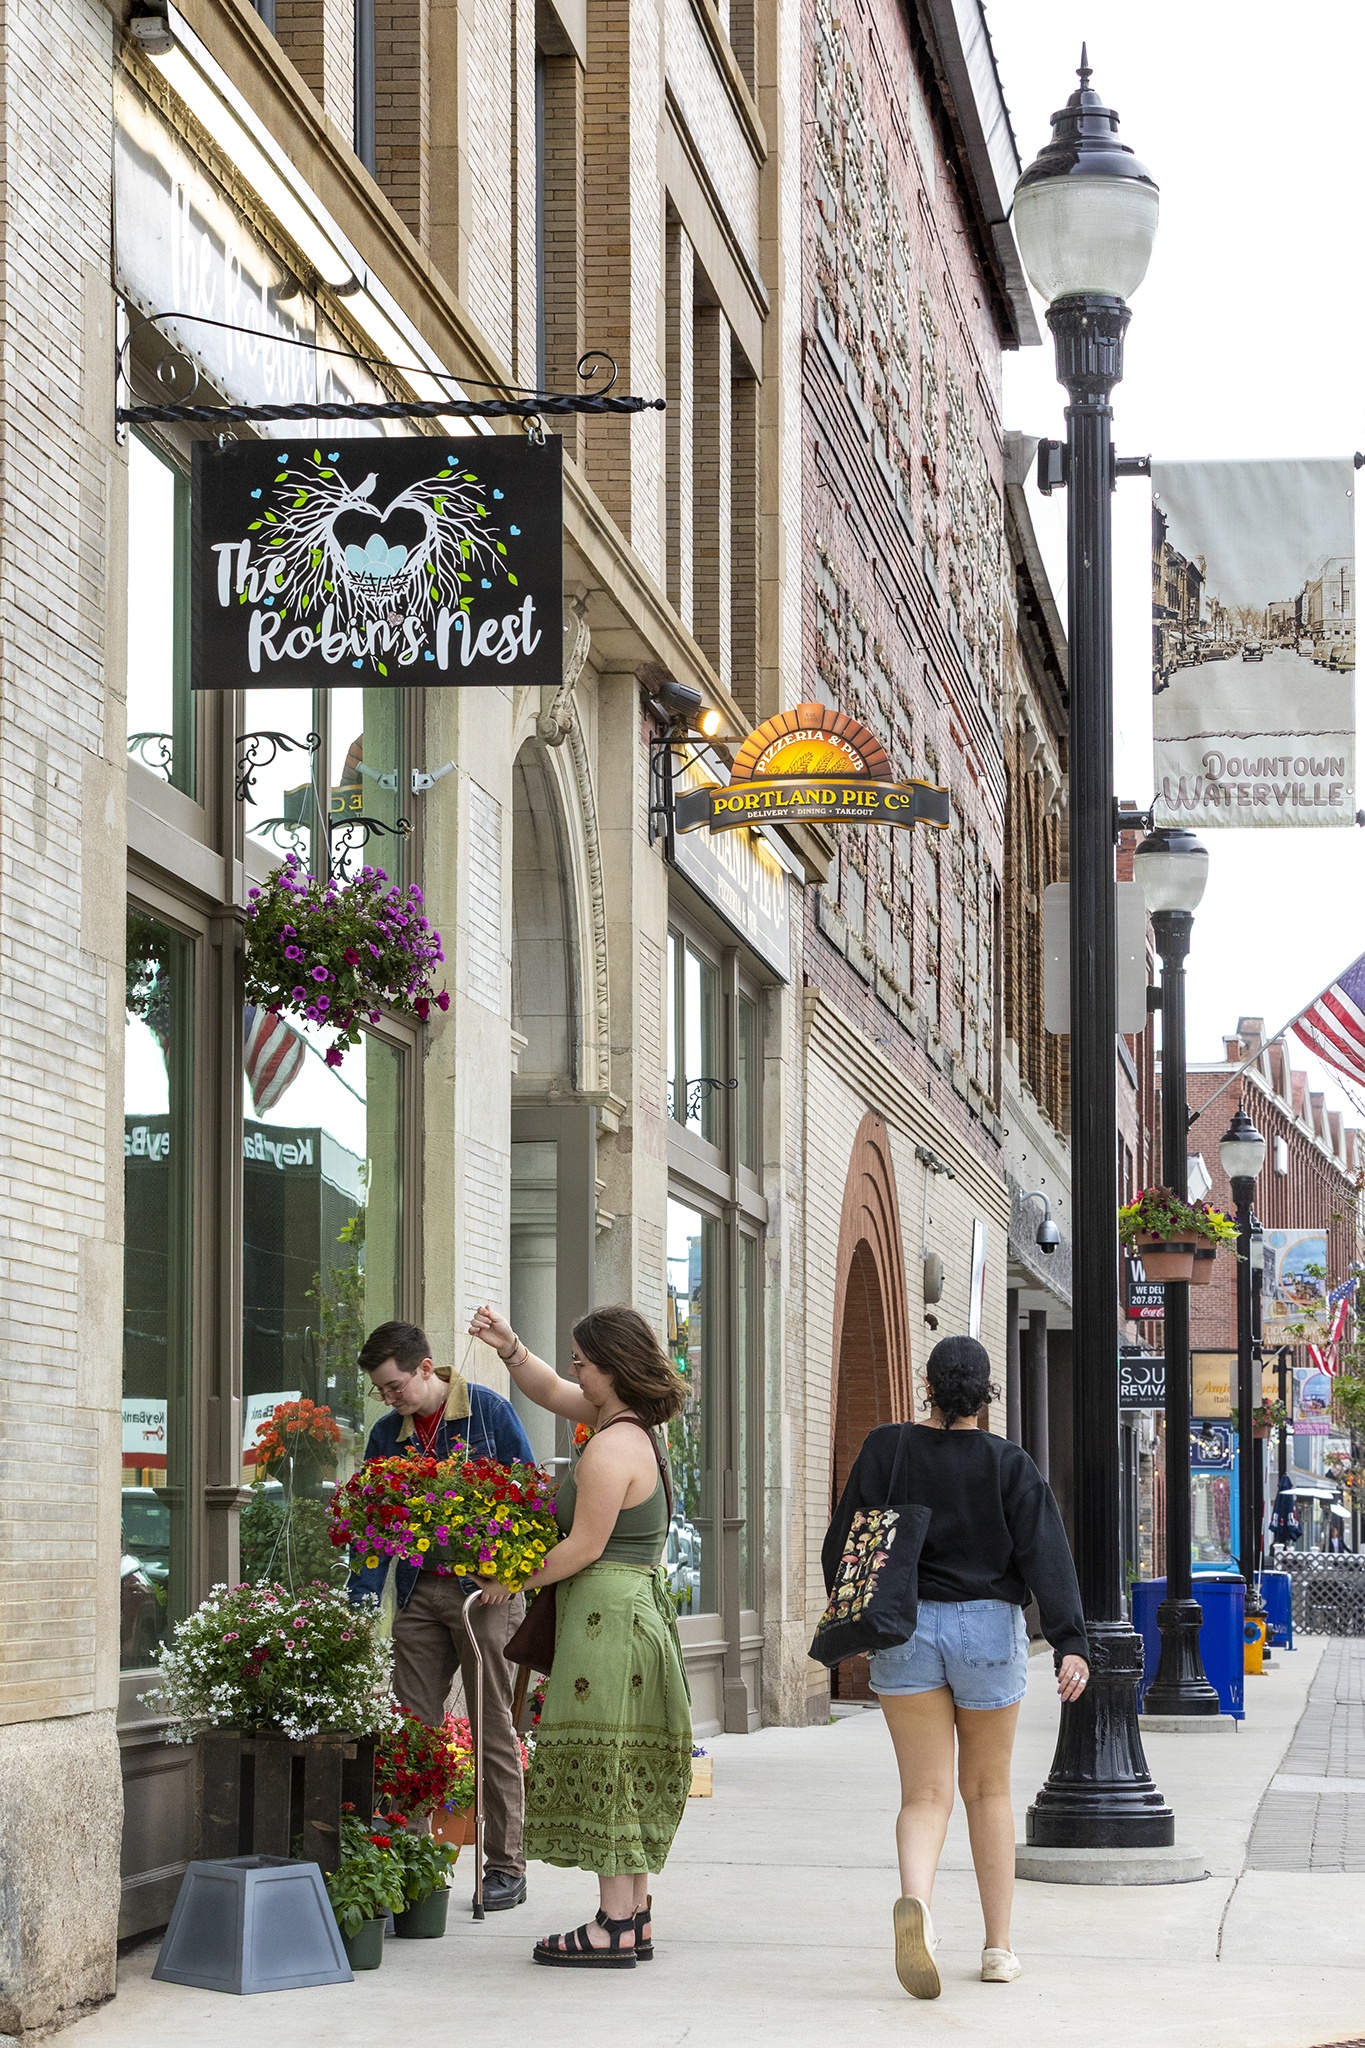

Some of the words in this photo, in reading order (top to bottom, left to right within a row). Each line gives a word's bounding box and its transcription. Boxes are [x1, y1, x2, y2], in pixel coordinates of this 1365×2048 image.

[211, 539, 296, 608] The
[436, 594, 543, 671] Nest
[757, 730, 824, 773] PIZZERIA
[829, 734, 841, 747] &
[841, 744, 864, 772] PUB
[713, 789, 837, 815] PORTLAND
[842, 789, 880, 806] PIE
[747, 809, 788, 819] DELIVERY
[797, 807, 826, 815] DINING
[835, 808, 874, 816] TAKEOUT
[752, 850, 772, 921] PIE
[747, 905, 757, 936] PUB
[1135, 1286, 1148, 1295] WE
[1149, 1286, 1165, 1295] DELI
[1131, 1295, 1164, 1305] 207.873.
[1140, 1307, 1165, 1318] Coca-C
[1121, 1367, 1166, 1384] SOU
[1121, 1384, 1166, 1396] REVIVA
[1197, 1380, 1230, 1395] Amic
[1214, 1395, 1230, 1404] Itali
